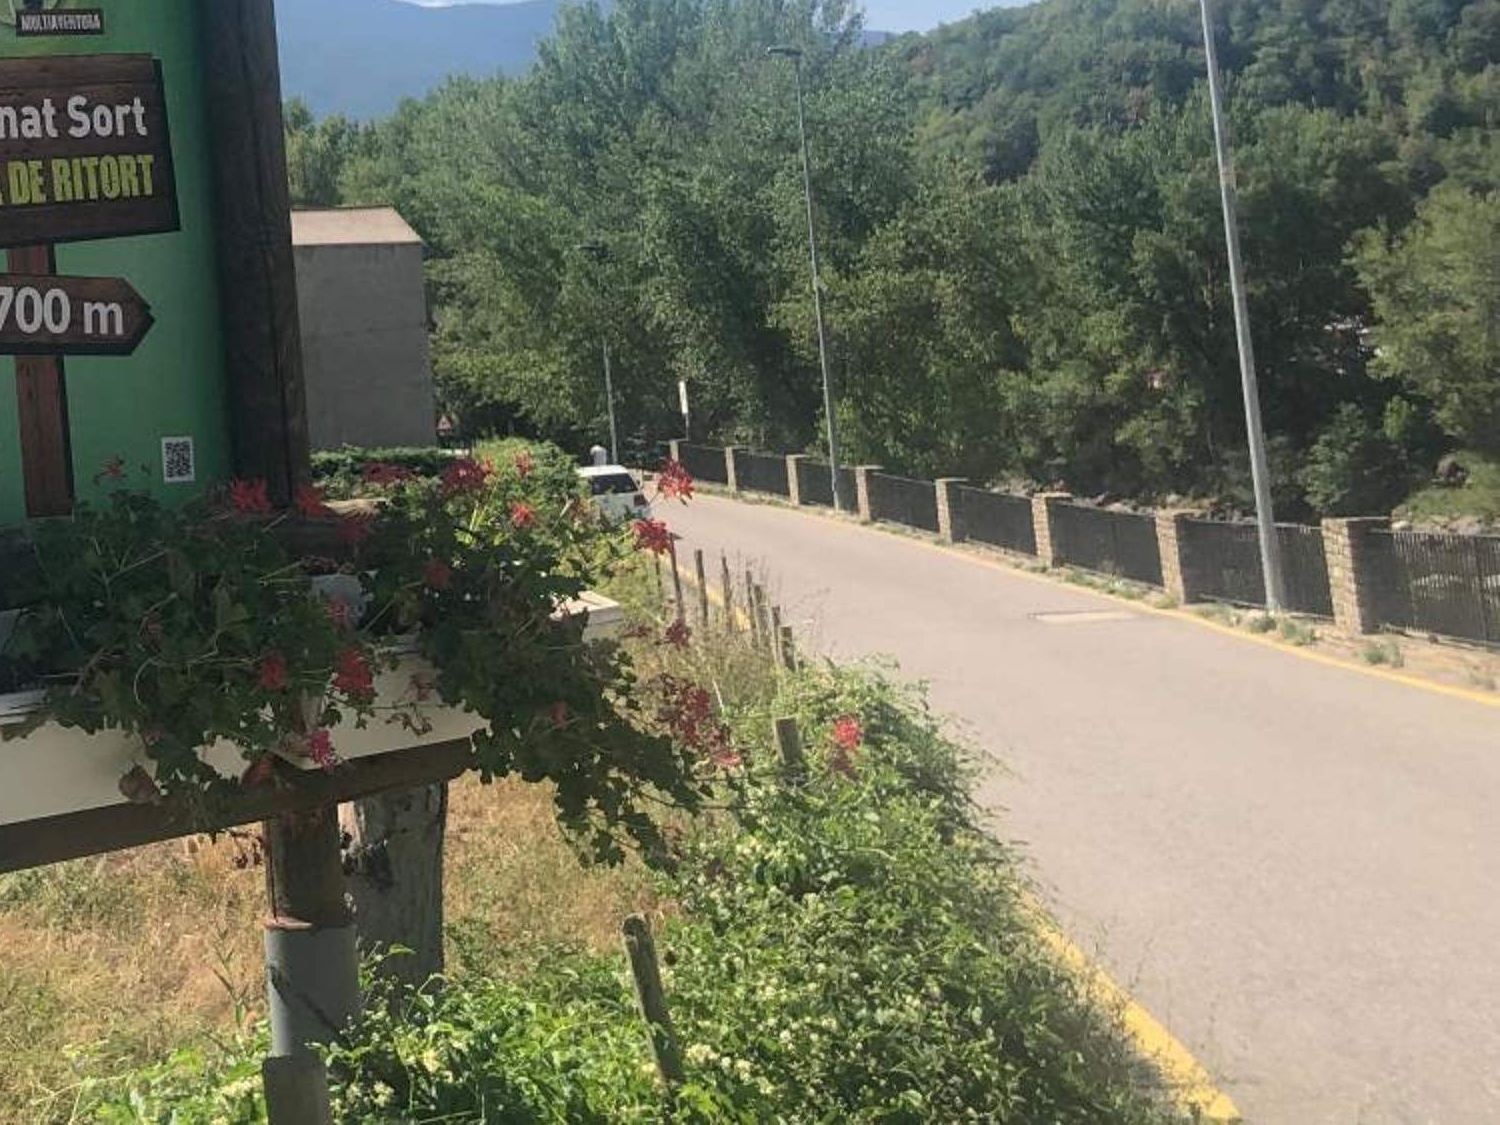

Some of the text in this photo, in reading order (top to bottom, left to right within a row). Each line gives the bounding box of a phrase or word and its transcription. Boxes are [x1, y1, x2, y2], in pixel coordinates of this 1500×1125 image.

[67, 95, 147, 138] Sort
[8, 160, 46, 205] DE
[51, 155, 154, 202] RITORT
[83, 301, 123, 335] m
